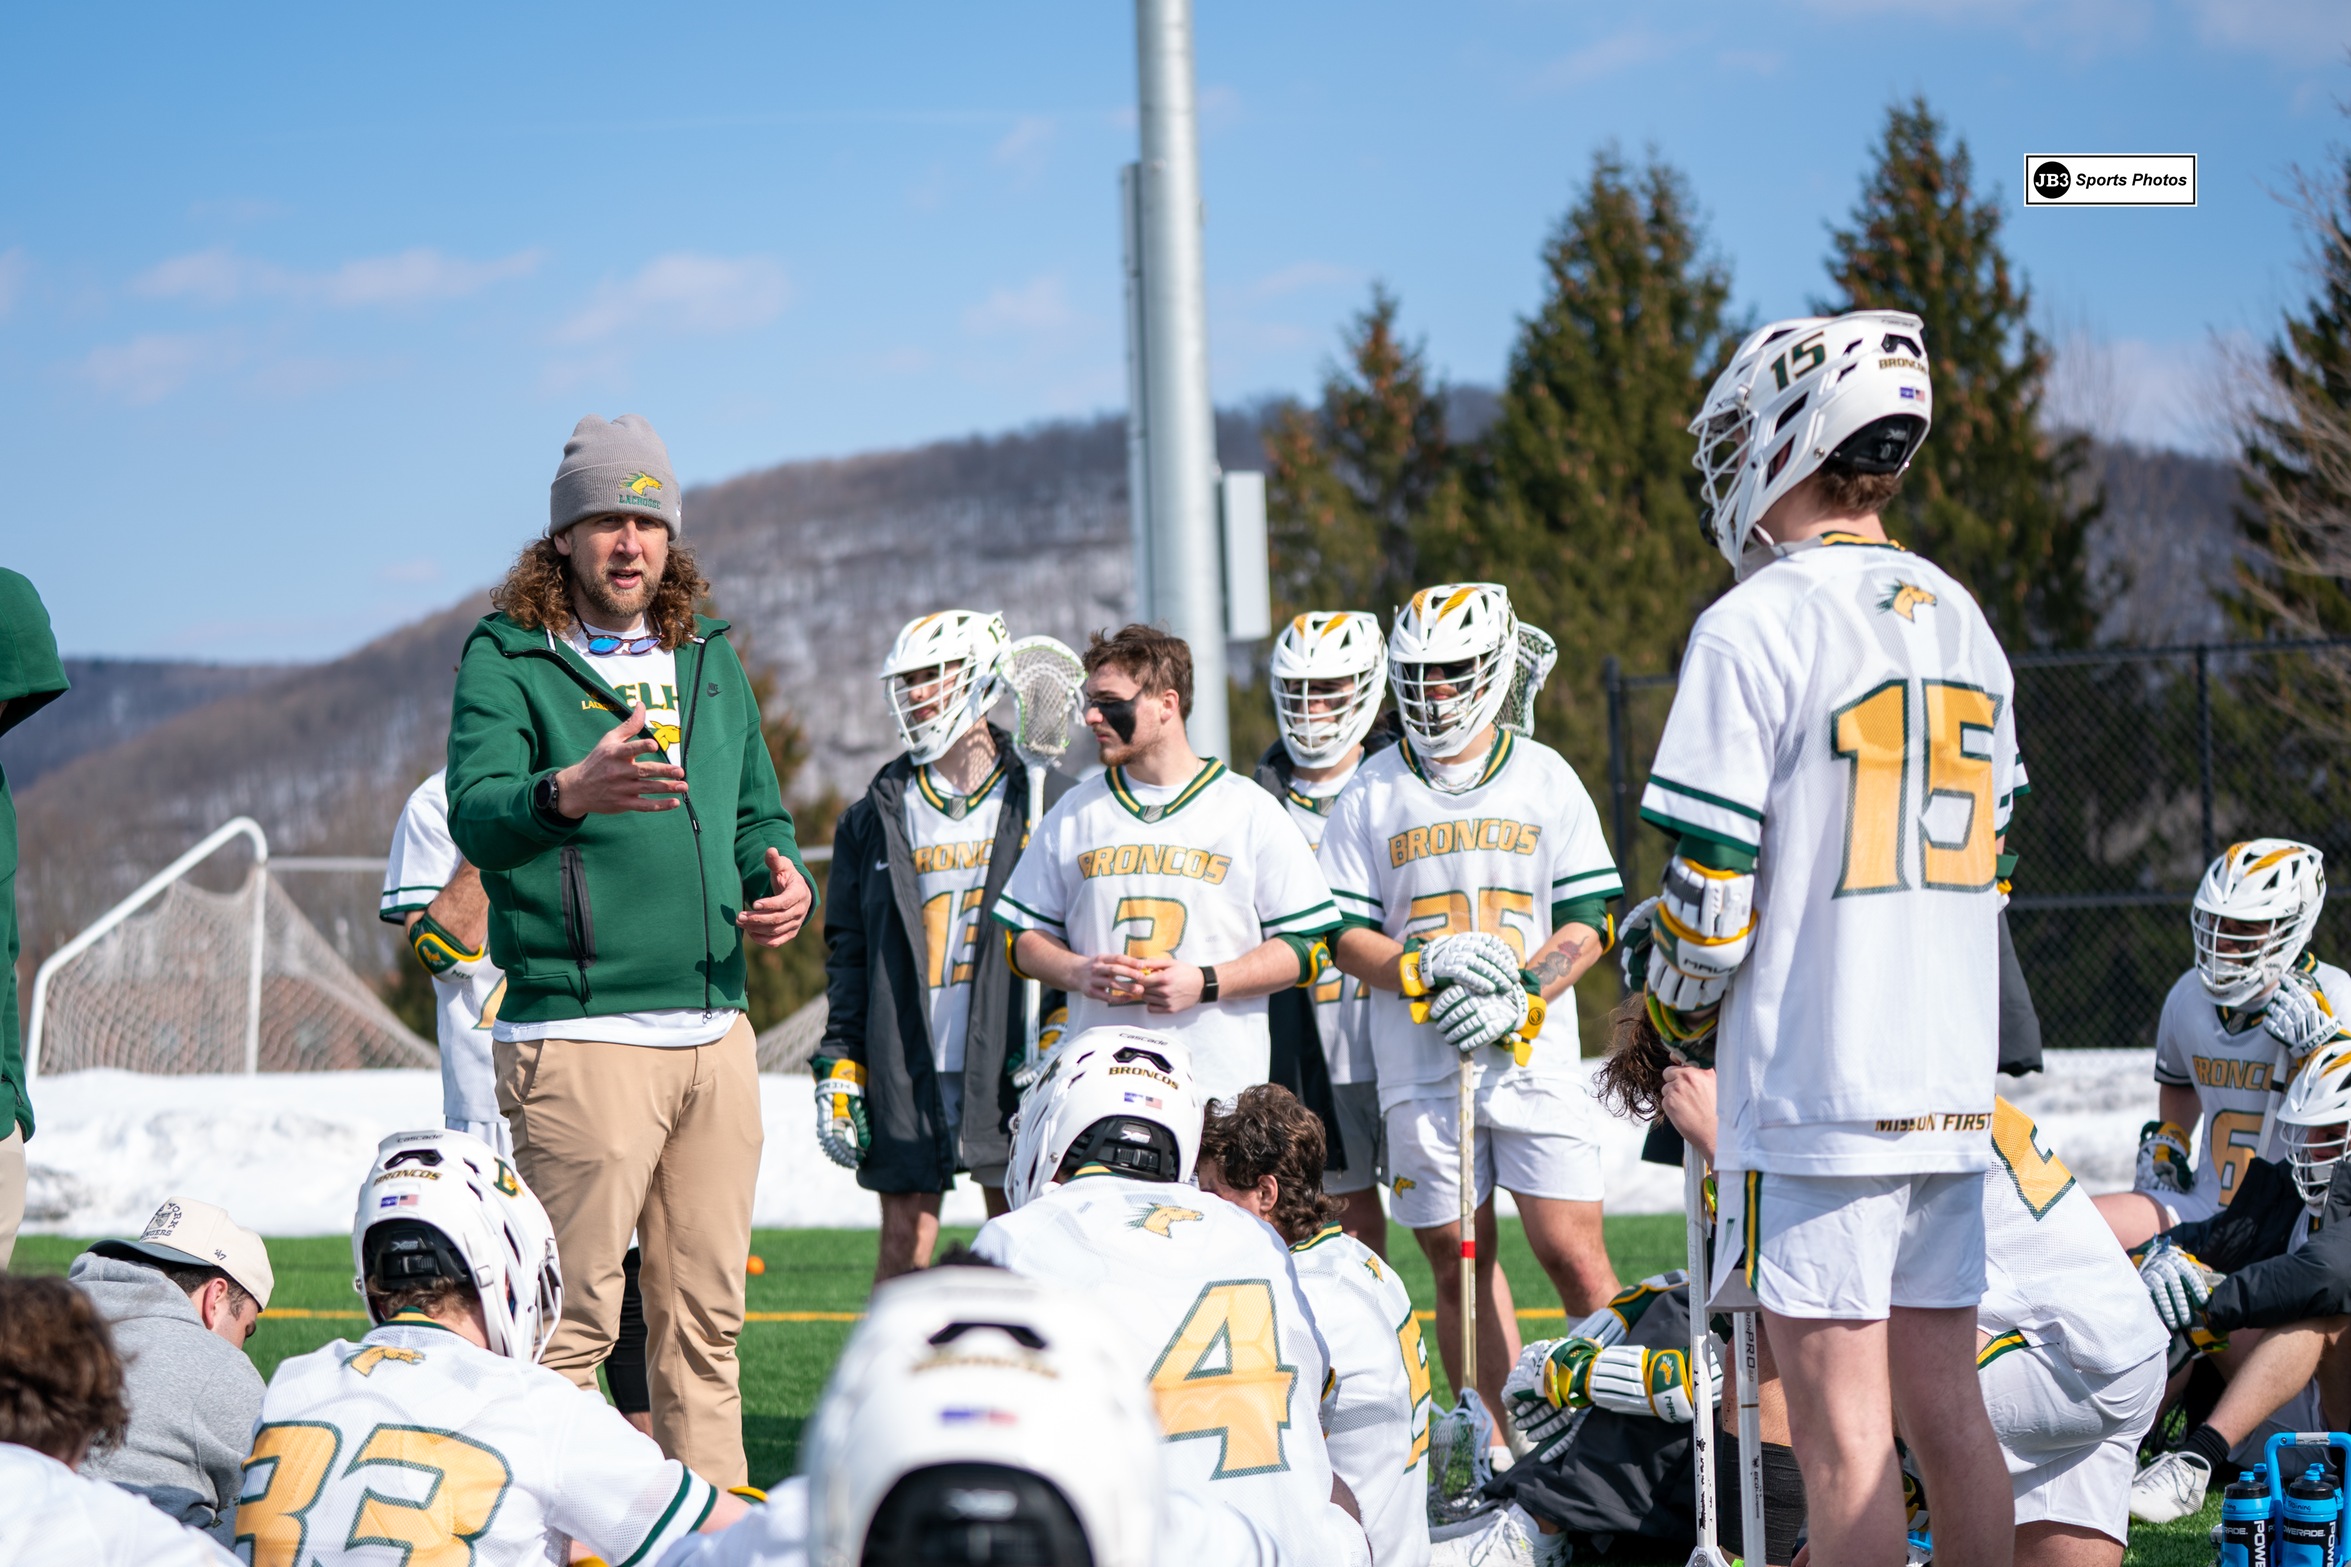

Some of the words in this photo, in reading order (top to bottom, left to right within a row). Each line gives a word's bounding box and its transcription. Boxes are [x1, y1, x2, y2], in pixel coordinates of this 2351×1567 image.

[1770, 331, 1827, 393] 15
[1878, 357, 1928, 376] BRONCO
[618, 495, 661, 510] LACROSSE
[581, 700, 625, 712] LACROSS
[1830, 678, 2004, 899] 15
[913, 838, 995, 876] RONC
[1387, 818, 1543, 870] BRONCOS
[1077, 843, 1233, 886] BRONCOS
[1108, 1066, 1179, 1090] BRONCOS
[1943, 1113, 1992, 1131] FIRST
[373, 1169, 443, 1187] BRONCOS
[1147, 1278, 1298, 1481] 4
